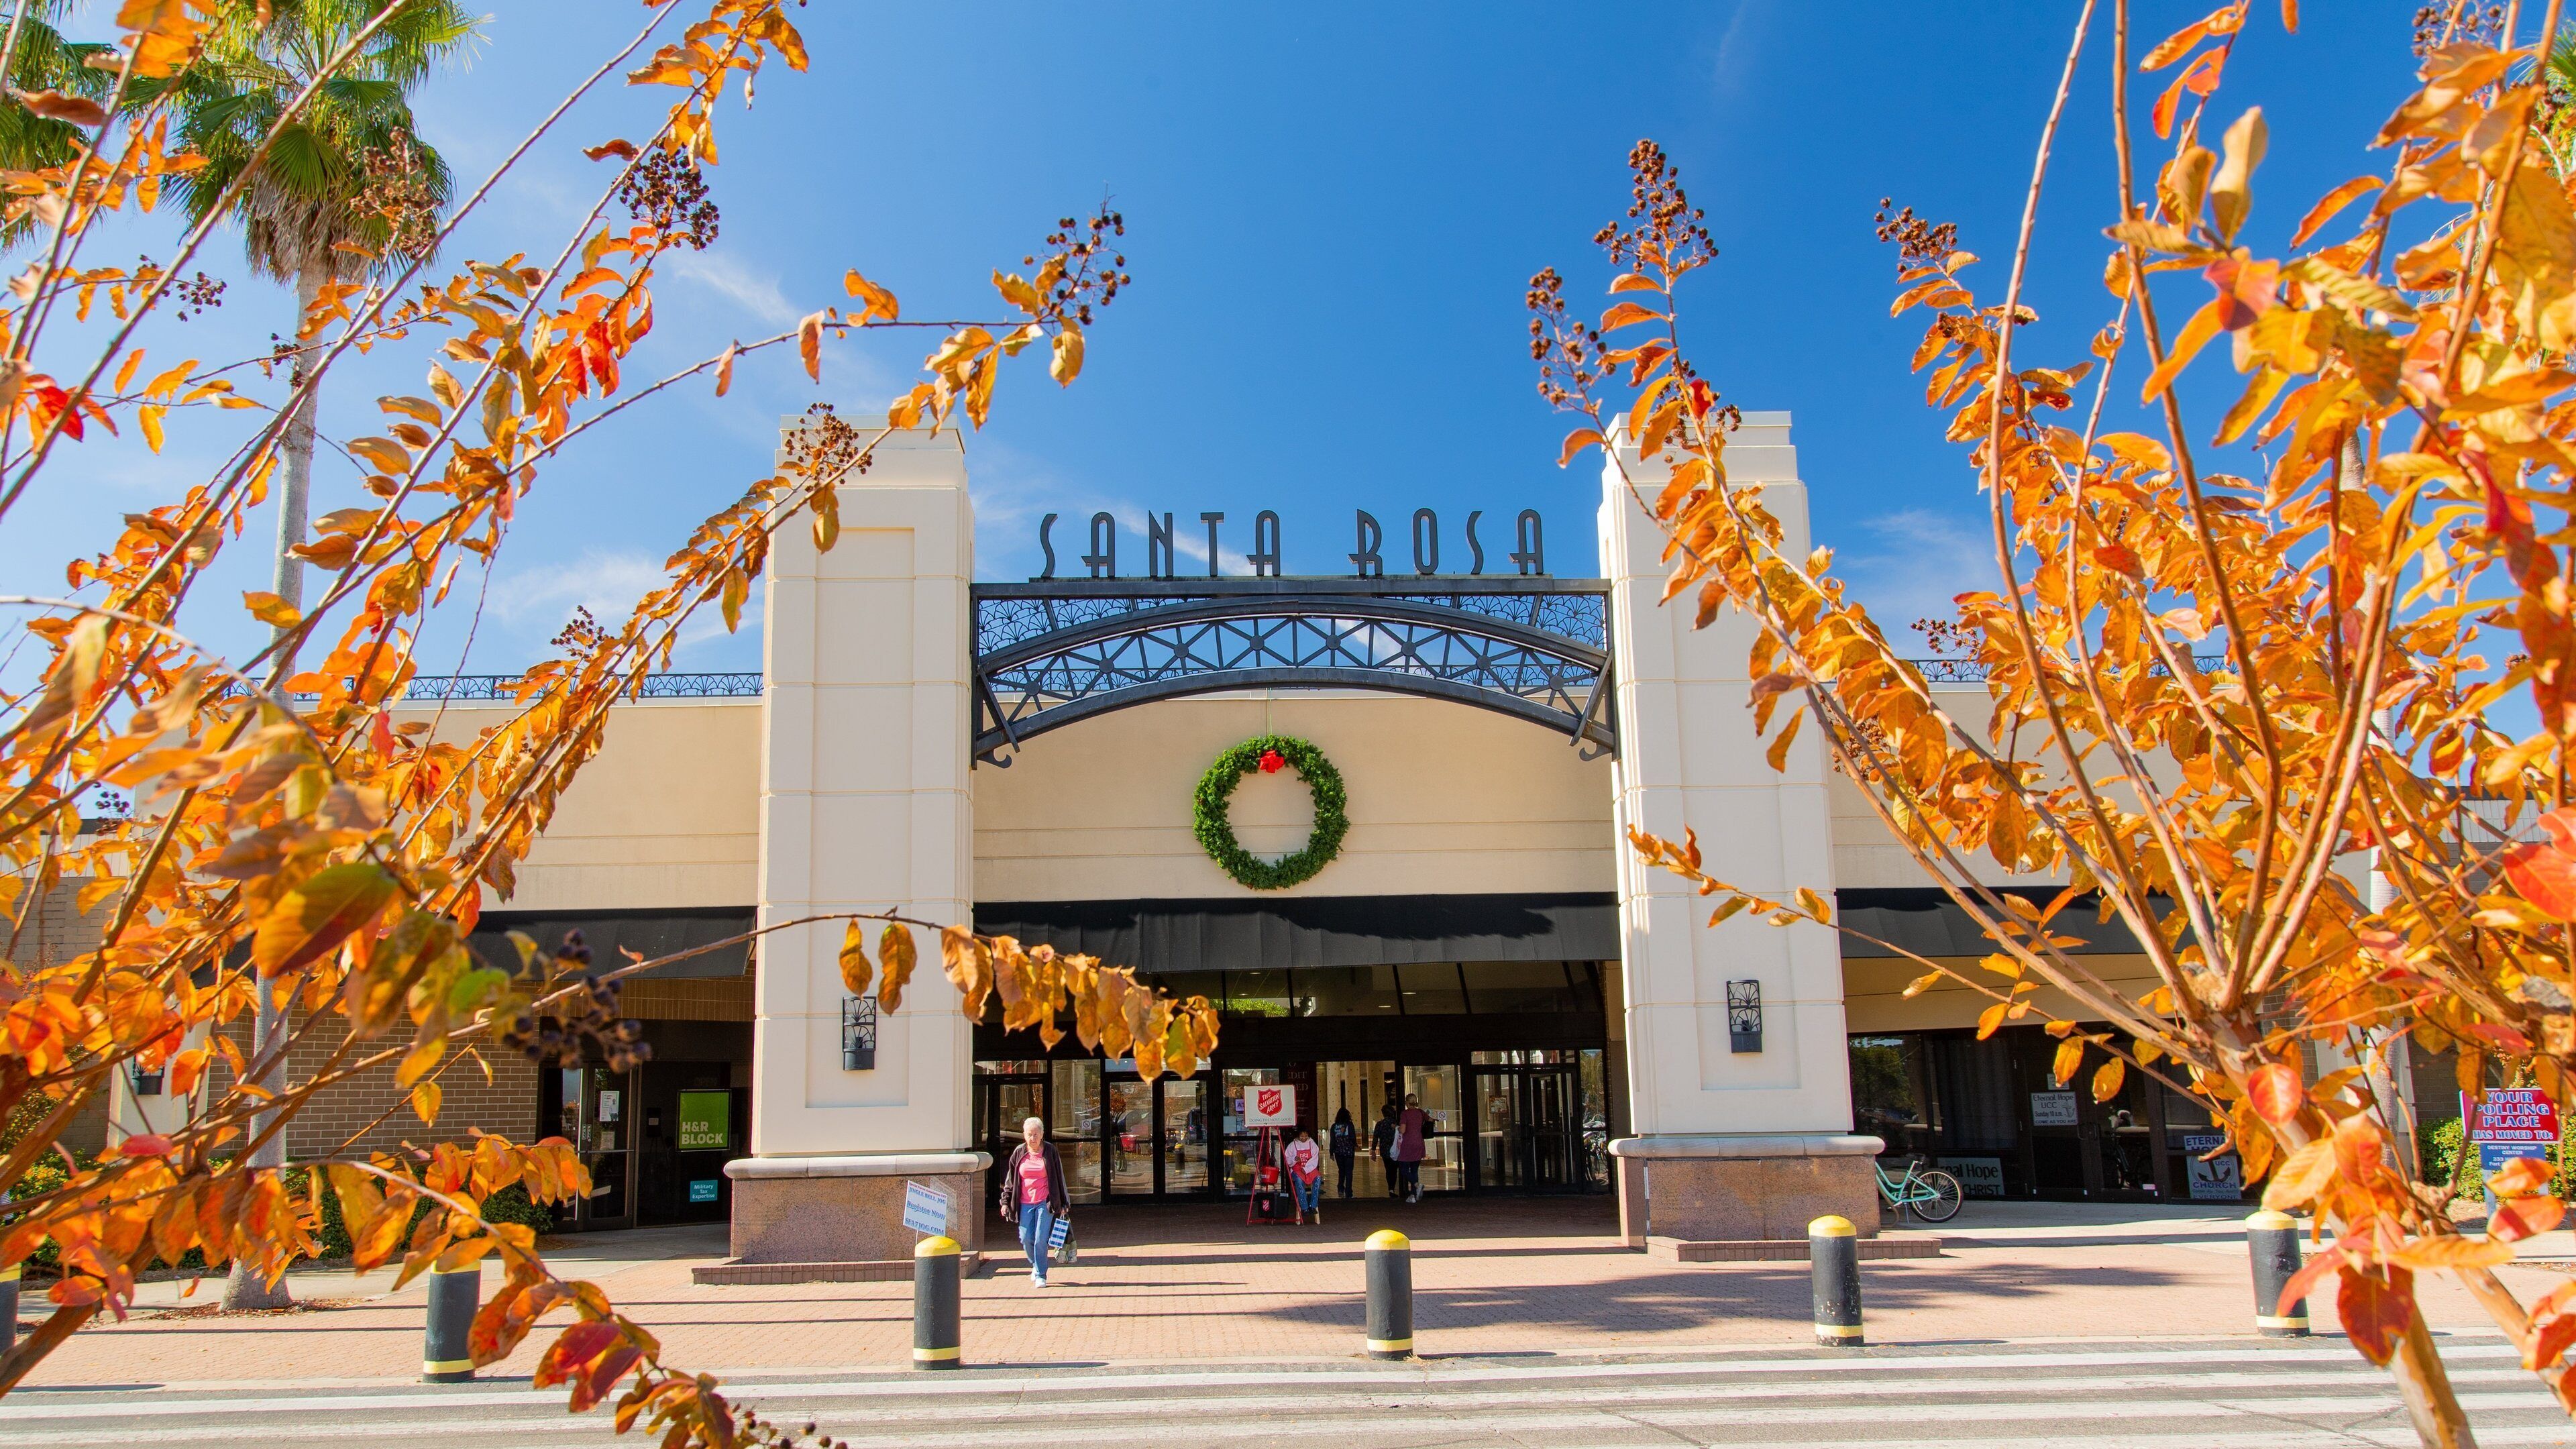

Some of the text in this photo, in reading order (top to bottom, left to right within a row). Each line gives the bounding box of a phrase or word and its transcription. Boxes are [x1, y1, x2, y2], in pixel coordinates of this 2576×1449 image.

[1040, 508, 1544, 578] SANTA ROSA
[1259, 1092, 1279, 1110] SALVATION
[1262, 1091, 1271, 1100] THE
[2487, 1091, 2534, 1103] YOUR
[1267, 1099, 1279, 1114] ARMY
[682, 1121, 709, 1132] H&R
[2483, 1116, 2540, 1127] PLACE
[681, 1133, 723, 1144] BLOCK
[2473, 1130, 2554, 1139] HAS MOVED TO:
[2186, 1137, 2225, 1146] ETERNA
[1966, 1163, 1998, 1180] Hope
[908, 1187, 924, 1197] JINGLE
[924, 1193, 936, 1201] BELL
[1963, 1183, 2000, 1195] CHRIST
[906, 1200, 946, 1220] Register Now
[906, 1218, 945, 1236] SFA7JOG.COM
